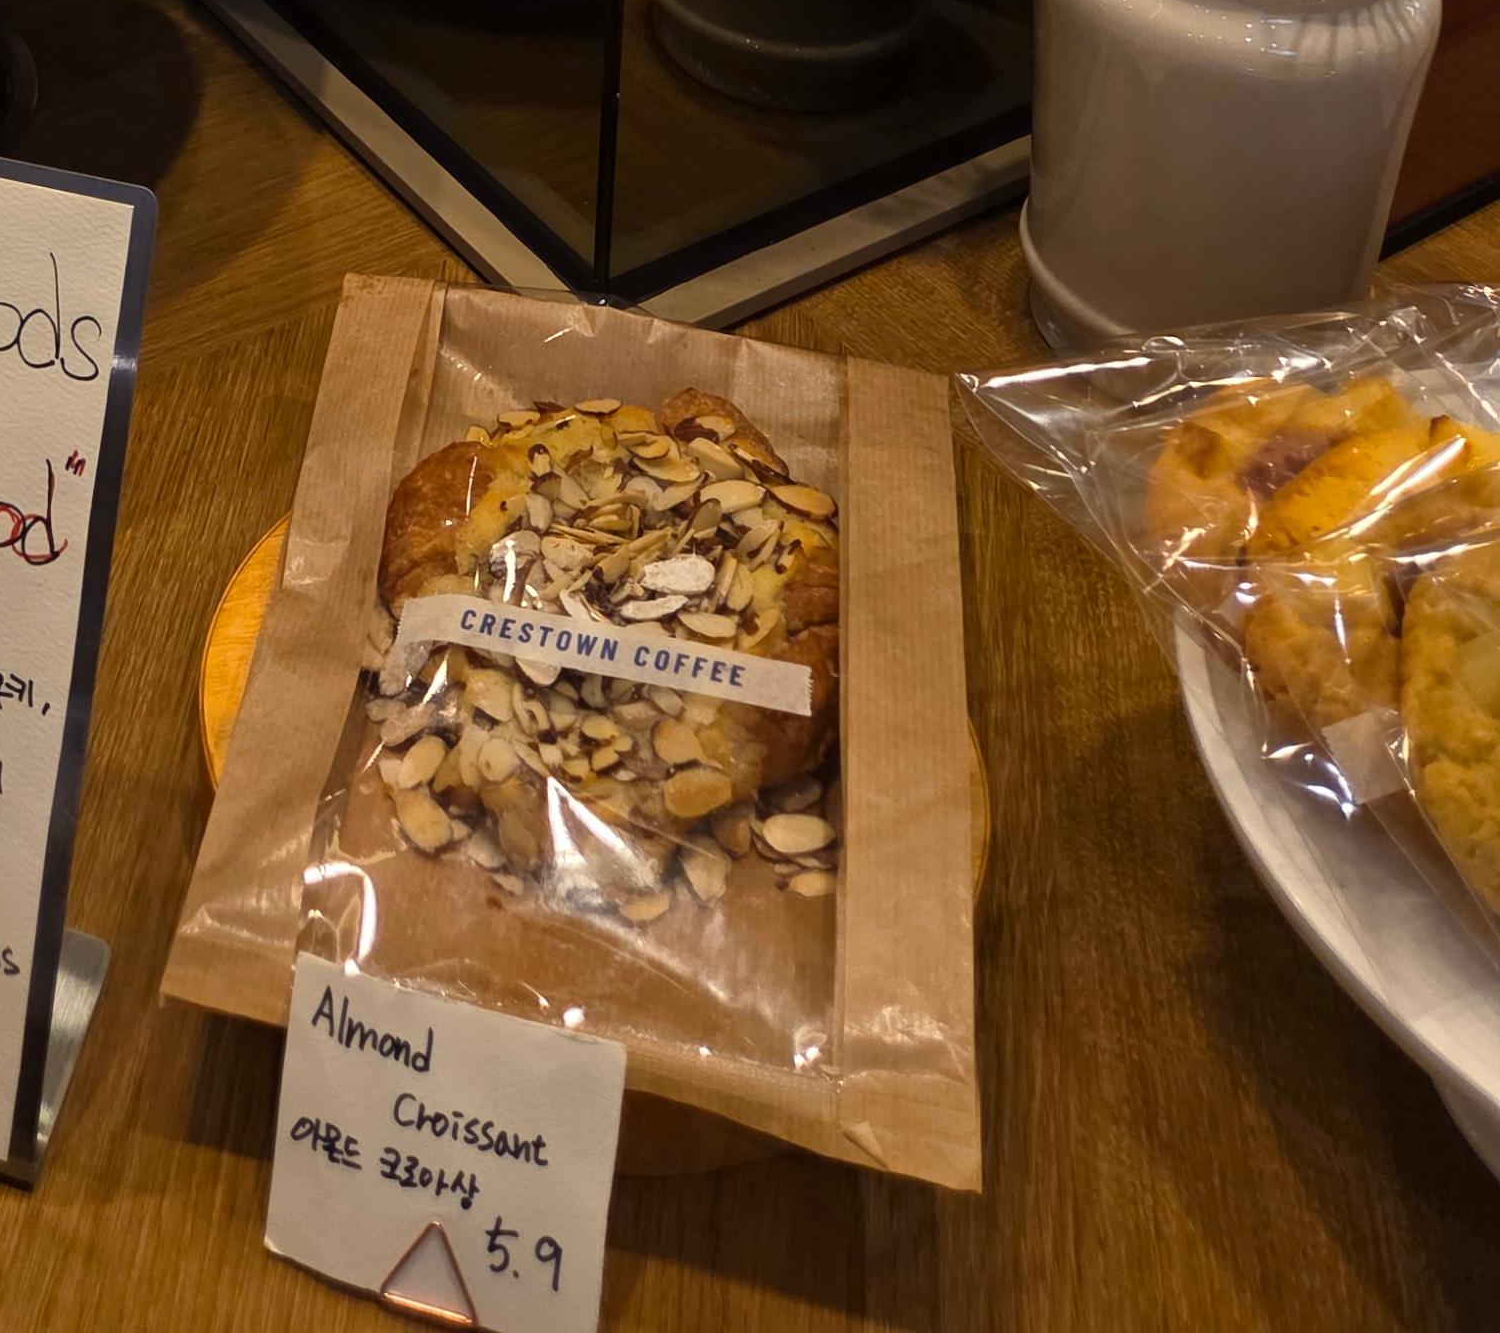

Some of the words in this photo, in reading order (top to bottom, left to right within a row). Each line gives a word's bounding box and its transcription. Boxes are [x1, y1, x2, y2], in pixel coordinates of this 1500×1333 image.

[460, 608, 620, 662] CRESTOWN
[632, 644, 749, 688] COFFEE
[310, 984, 436, 1074] Almond
[289, 1116, 364, 1171] 아몬드
[392, 1091, 550, 1168] Croissant
[485, 1215, 565, 1293] 5.9
